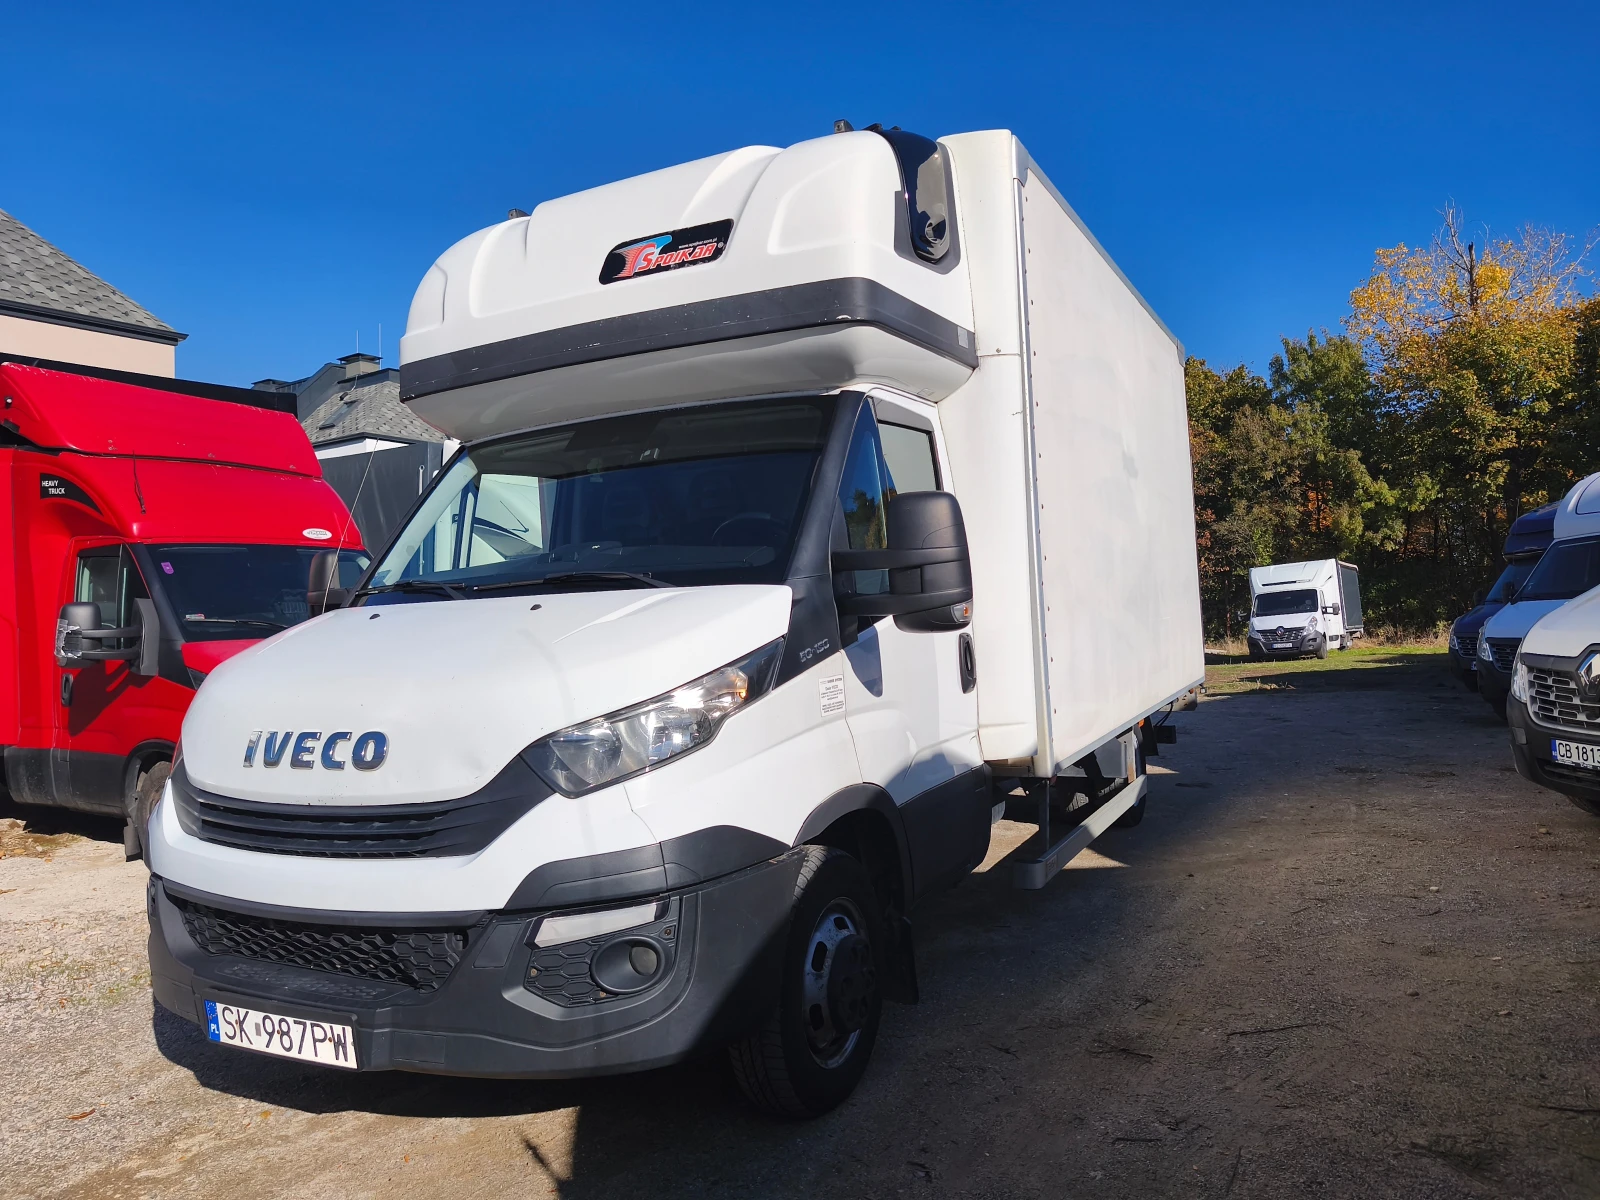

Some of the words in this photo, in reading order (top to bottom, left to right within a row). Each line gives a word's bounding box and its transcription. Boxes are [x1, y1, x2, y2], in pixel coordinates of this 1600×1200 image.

[48, 487, 66, 495] TRUCK
[243, 731, 390, 771] IVECO
[1558, 742, 1573, 759] CB
[210, 1023, 220, 1034] PL
[222, 1006, 253, 1045] SK
[262, 1015, 349, 1062] 987PW
